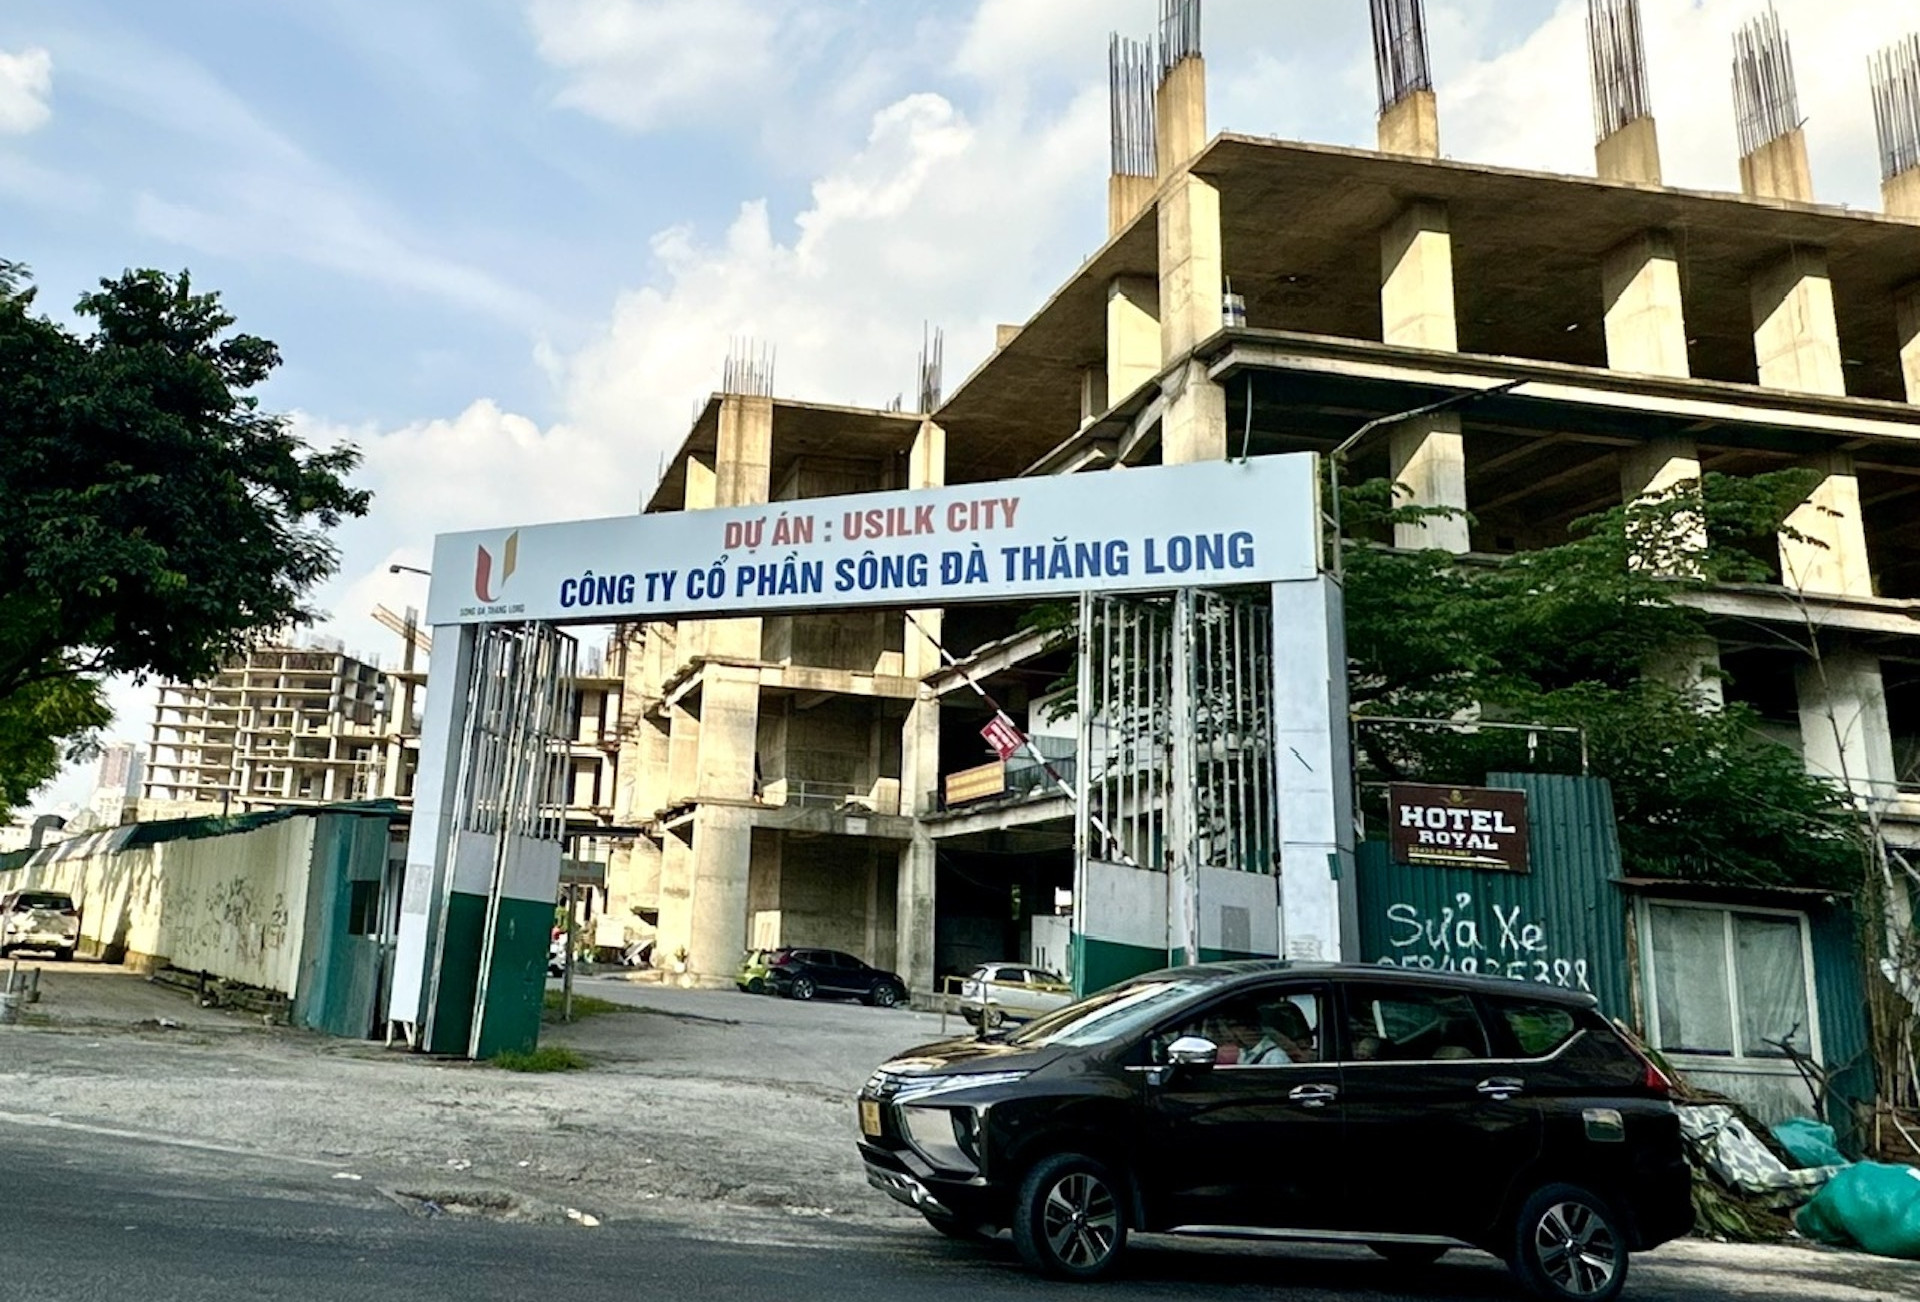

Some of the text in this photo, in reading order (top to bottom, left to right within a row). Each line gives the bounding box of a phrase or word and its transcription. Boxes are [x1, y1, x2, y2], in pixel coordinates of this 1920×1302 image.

[724, 517, 767, 554] DỰ
[772, 511, 814, 546] ÁN
[843, 505, 934, 540] USILK
[947, 498, 1020, 532] CITY
[560, 531, 1255, 608] CÔNG TY CỔ PHẦN SÔNG ĐÀ THĂNG LONG
[1400, 804, 1516, 834] HOTEL
[1418, 830, 1499, 850] ROYAL
[1492, 904, 1548, 953] Xe
